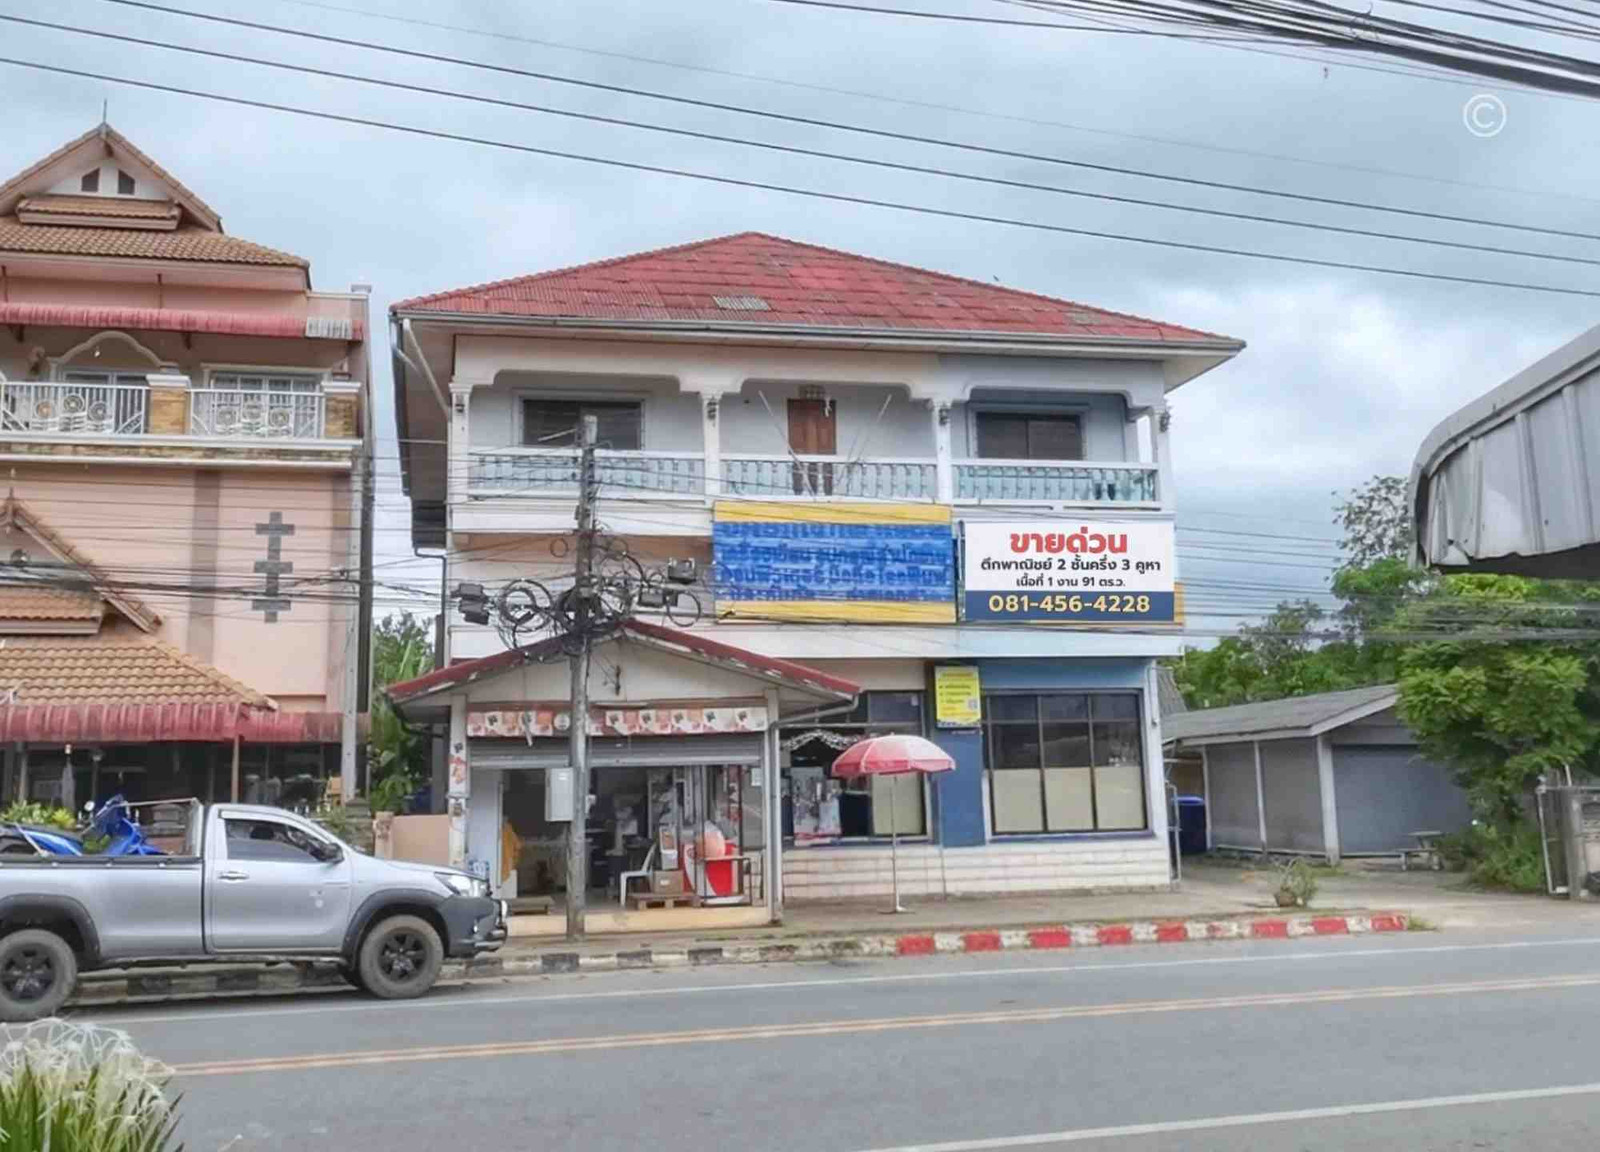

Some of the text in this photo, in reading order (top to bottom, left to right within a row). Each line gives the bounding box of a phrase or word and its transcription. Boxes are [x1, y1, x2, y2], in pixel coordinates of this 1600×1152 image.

[1010, 526, 1128, 554] ขายด่วน
[1057, 558, 1067, 571] 2
[1070, 554, 1117, 571] ชั้นครึ่ง
[1121, 558, 1131, 571] 3
[1135, 560, 1161, 575] คูหา
[1015, 573, 1044, 587] เนื้อที่
[1047, 577, 1053, 587] 1
[1057, 578, 1079, 587] งาน
[1081, 576, 1095, 587] 91
[988, 595, 1150, 612] 081-456-4228
